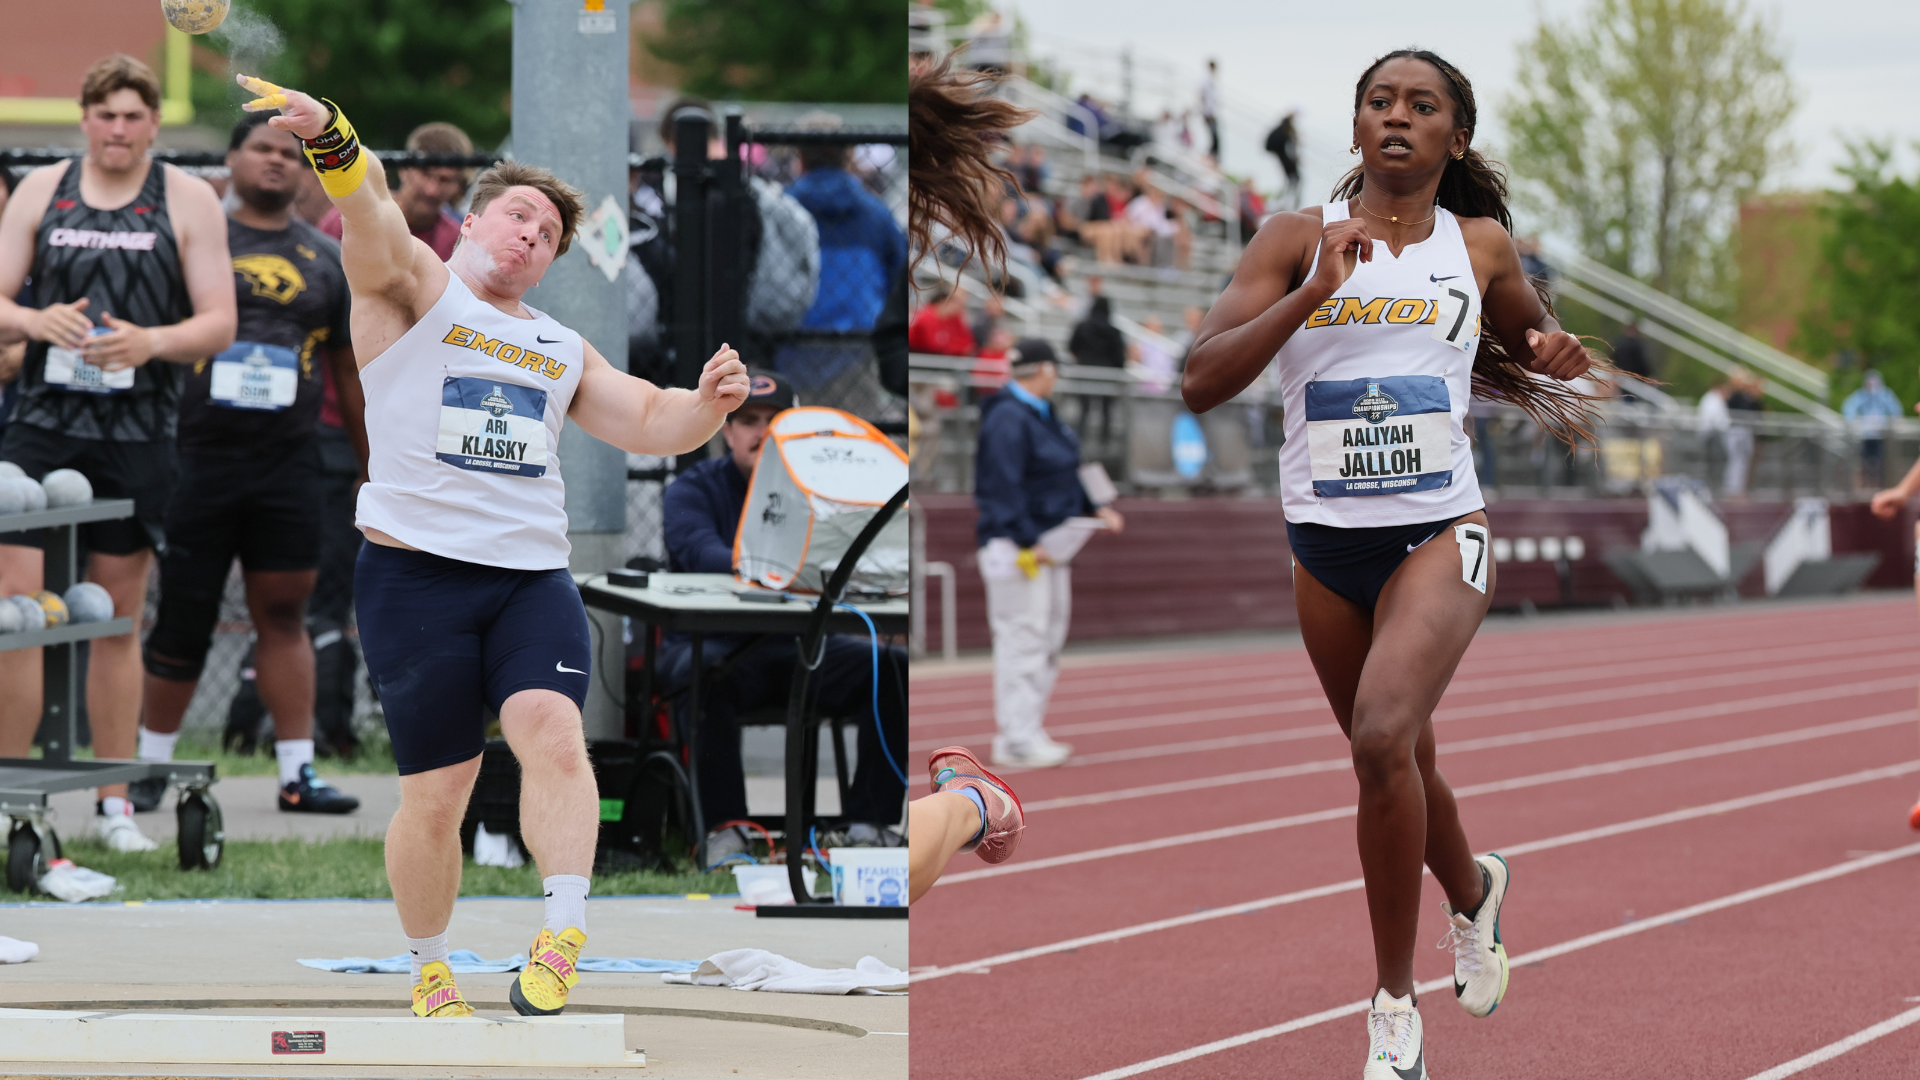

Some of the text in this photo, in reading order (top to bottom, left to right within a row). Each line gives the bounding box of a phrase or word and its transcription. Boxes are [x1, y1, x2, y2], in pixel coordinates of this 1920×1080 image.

[48, 228, 157, 251] CARTHAGE
[1305, 297, 1481, 337] EMO
[1448, 288, 1470, 342] 7
[442, 323, 567, 380] EMORY
[1353, 403, 1397, 412] CHAMPIONSHIPS
[485, 418, 508, 435] ARI
[1343, 424, 1414, 447] AALIYAH
[461, 435, 528, 461] KLASKY
[472, 459, 492, 468] CROSSE,
[493, 461, 521, 471] WISCONSIN
[1339, 448, 1422, 477] JALLOH
[1346, 478, 1418, 490] LA CROSSE, WISCONSIN
[1465, 530, 1485, 583] 7
[865, 866, 909, 877] FAMILY
[537, 950, 574, 980] NIKE
[426, 987, 461, 1012] NIKE
